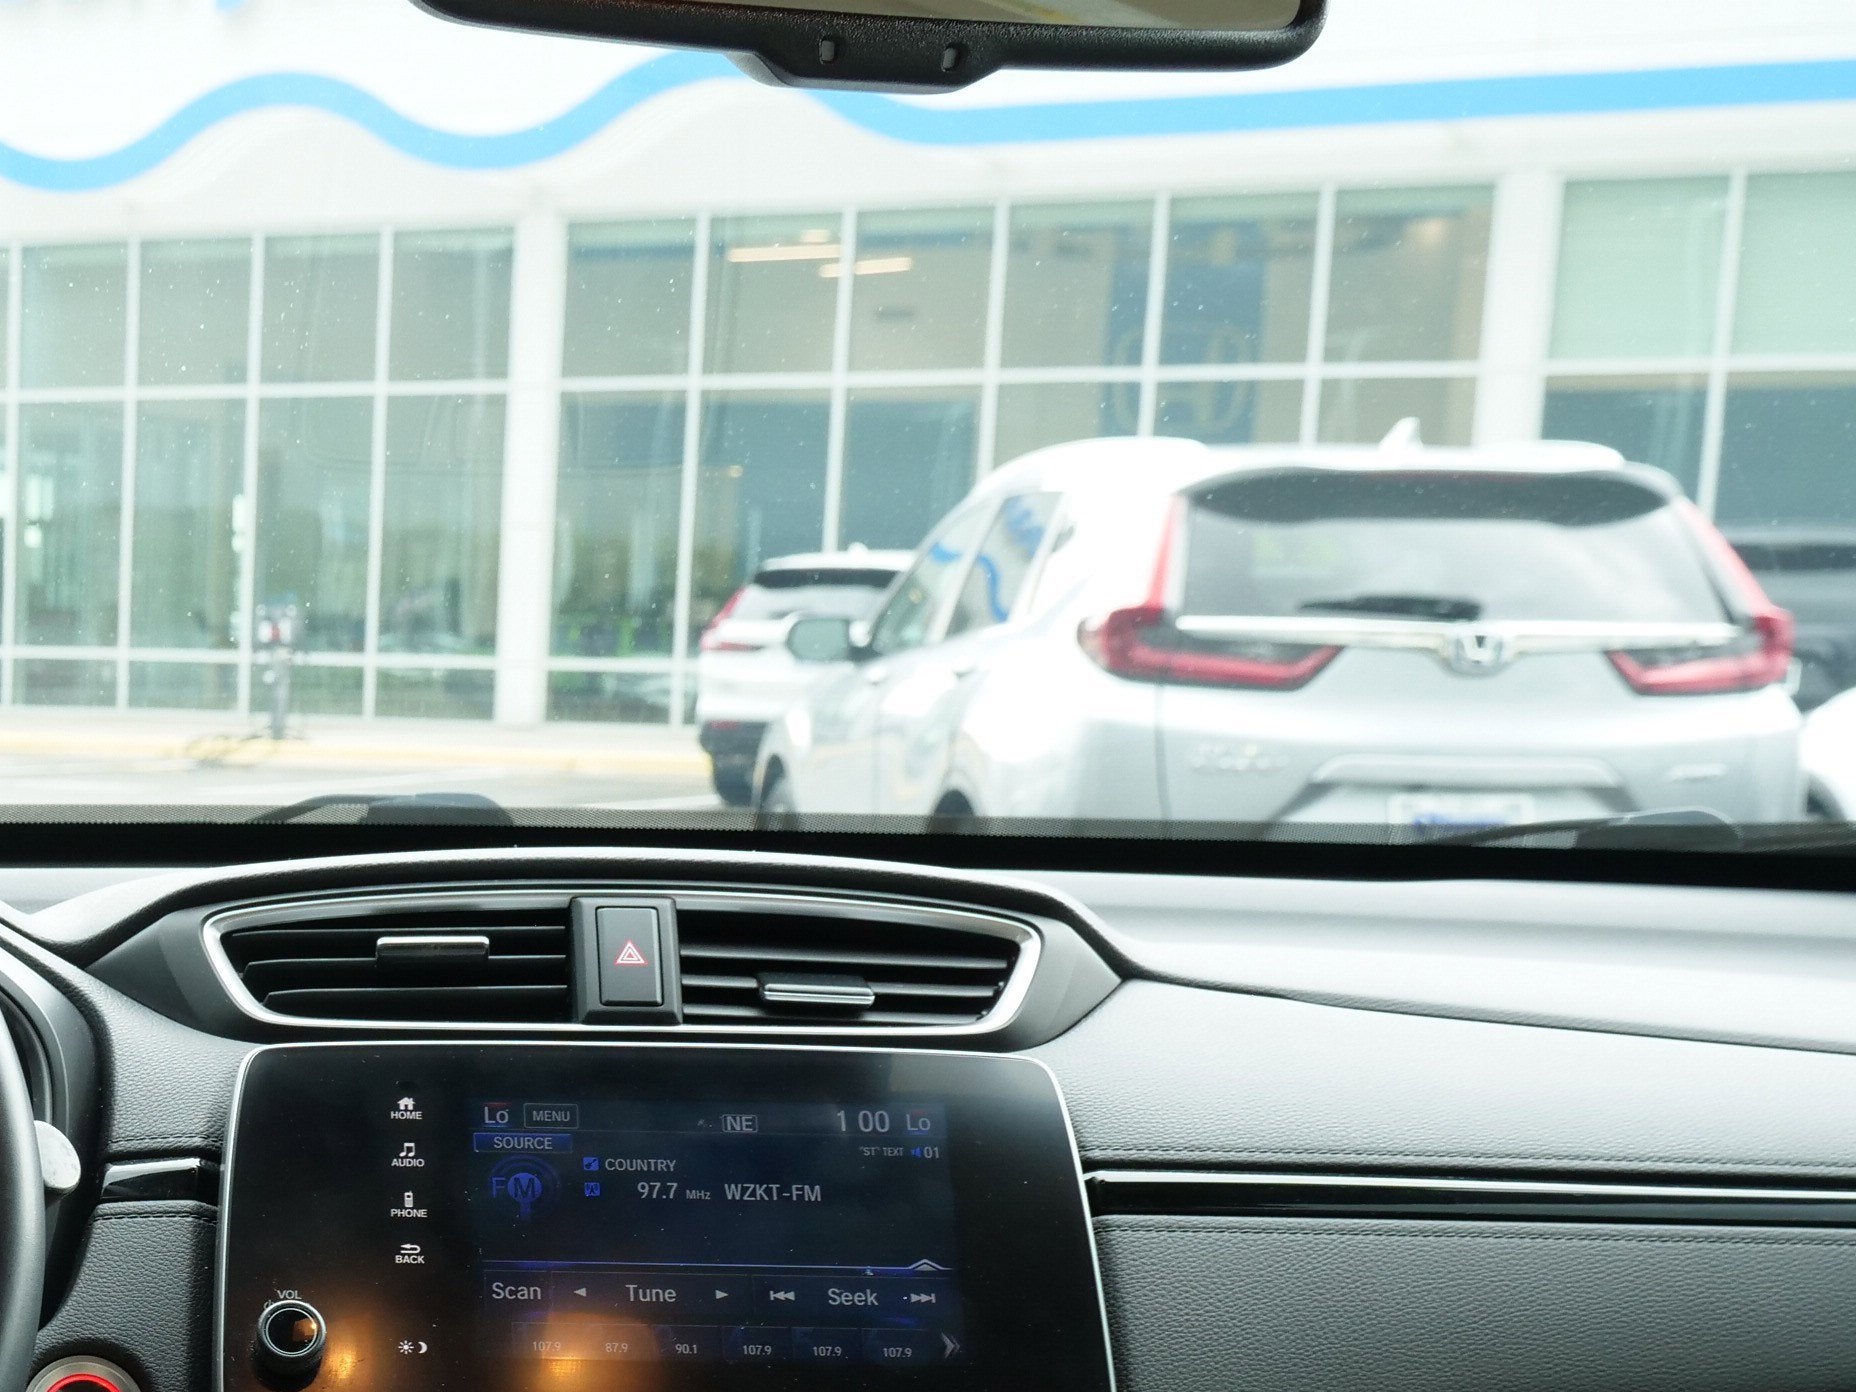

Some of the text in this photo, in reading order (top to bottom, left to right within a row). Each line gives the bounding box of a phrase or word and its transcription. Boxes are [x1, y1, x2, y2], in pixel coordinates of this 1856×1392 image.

[390, 1110, 423, 1121] HOME
[484, 1106, 571, 1124] Lo MENU
[726, 1115, 754, 1132] NE
[906, 1113, 931, 1131] Lo
[493, 1136, 554, 1150] SOURCE
[882, 1147, 904, 1157] TEXT
[924, 1146, 940, 1159] 01
[390, 1158, 425, 1168] AUDIO
[604, 1158, 677, 1172] COUNTRY
[637, 1181, 822, 1202] 97.7 MHz WZKT-FM
[390, 1208, 428, 1218] PHONE
[394, 1254, 426, 1265] BACK
[276, 1290, 303, 1301] VOL
[491, 1281, 879, 1306] Scan Tune Seek
[532, 1341, 562, 1353] 107.9
[604, 1342, 629, 1354] 87.9
[675, 1343, 698, 1355] 90.1
[742, 1344, 772, 1356] 107.9
[812, 1345, 842, 1357] 107.9
[882, 1347, 913, 1359] 107.9
